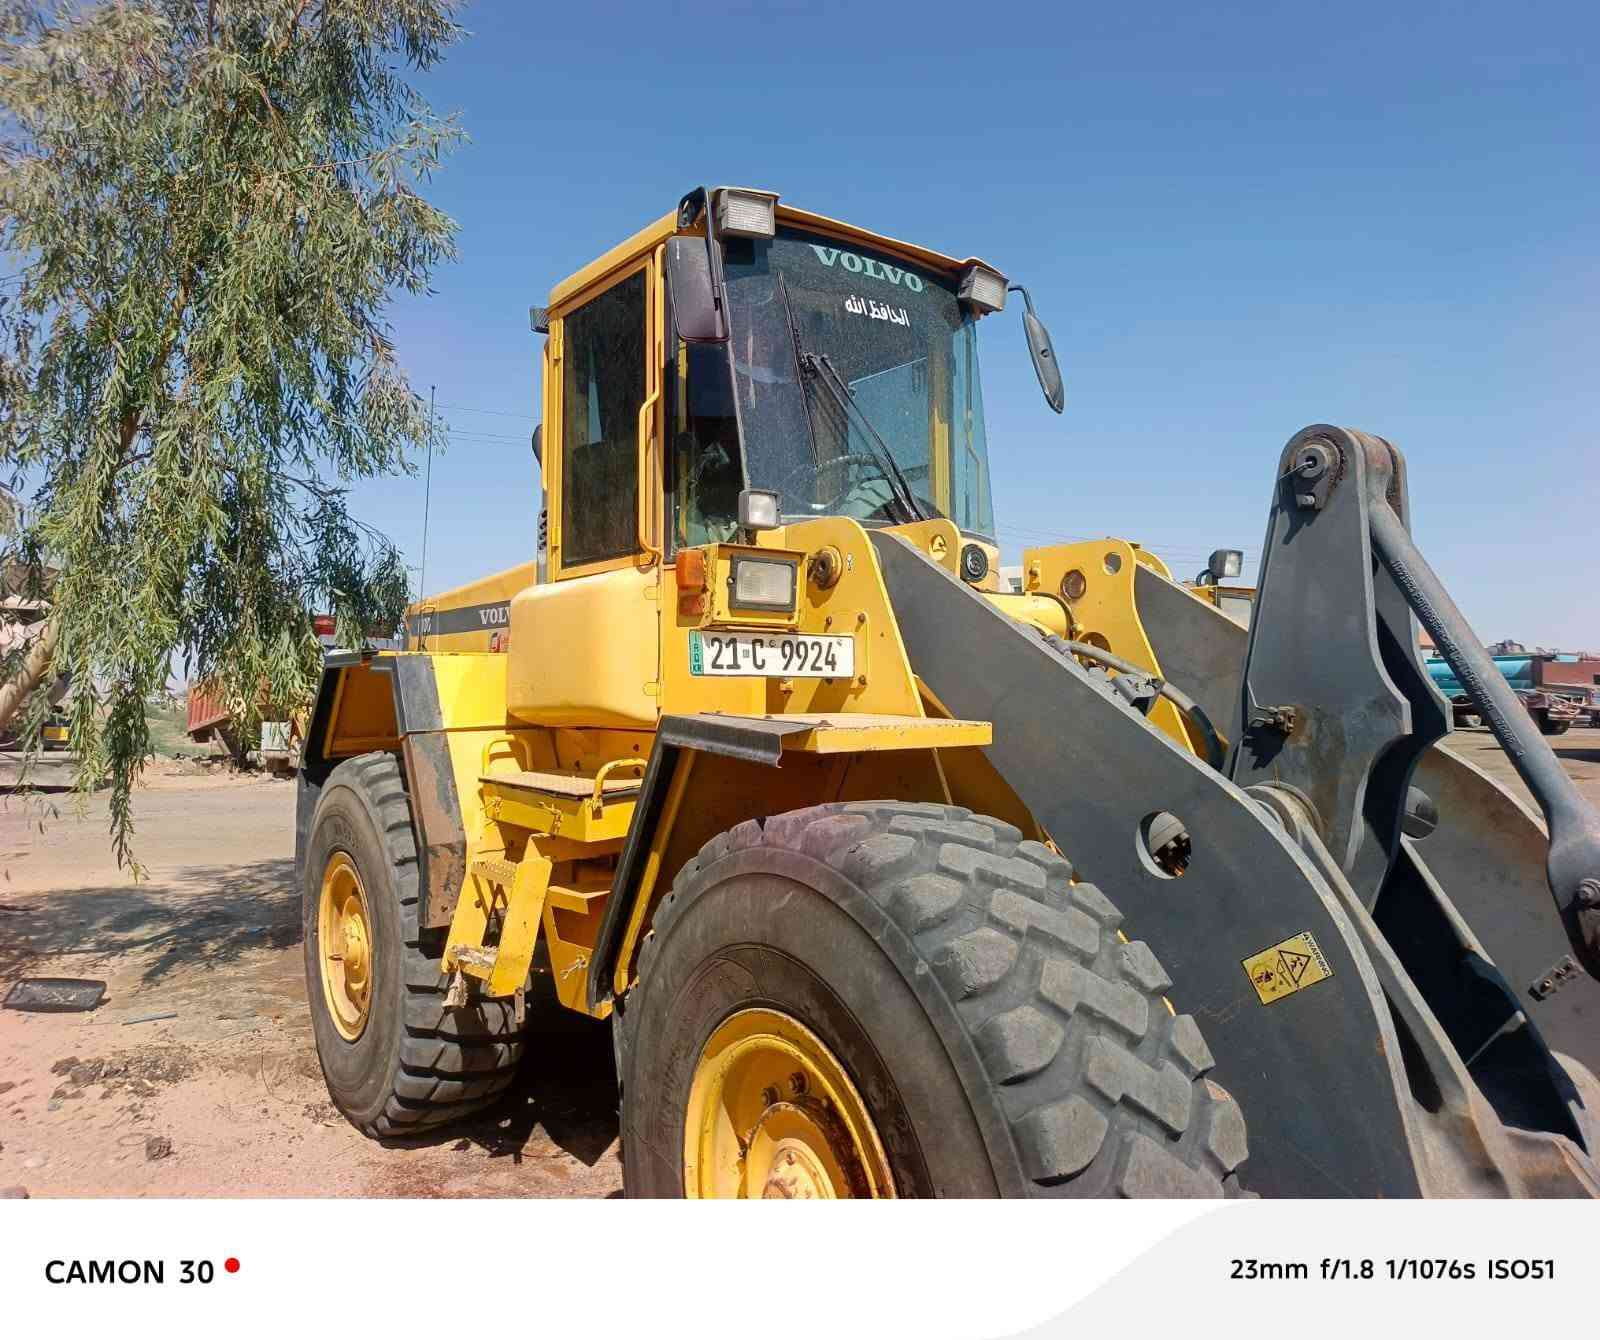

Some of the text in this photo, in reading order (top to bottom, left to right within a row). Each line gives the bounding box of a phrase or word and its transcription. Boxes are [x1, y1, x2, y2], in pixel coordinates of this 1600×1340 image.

[809, 244, 923, 292] VOLVO
[845, 294, 910, 328] الحافظ الله
[711, 637, 837, 672] 21 C 9924
